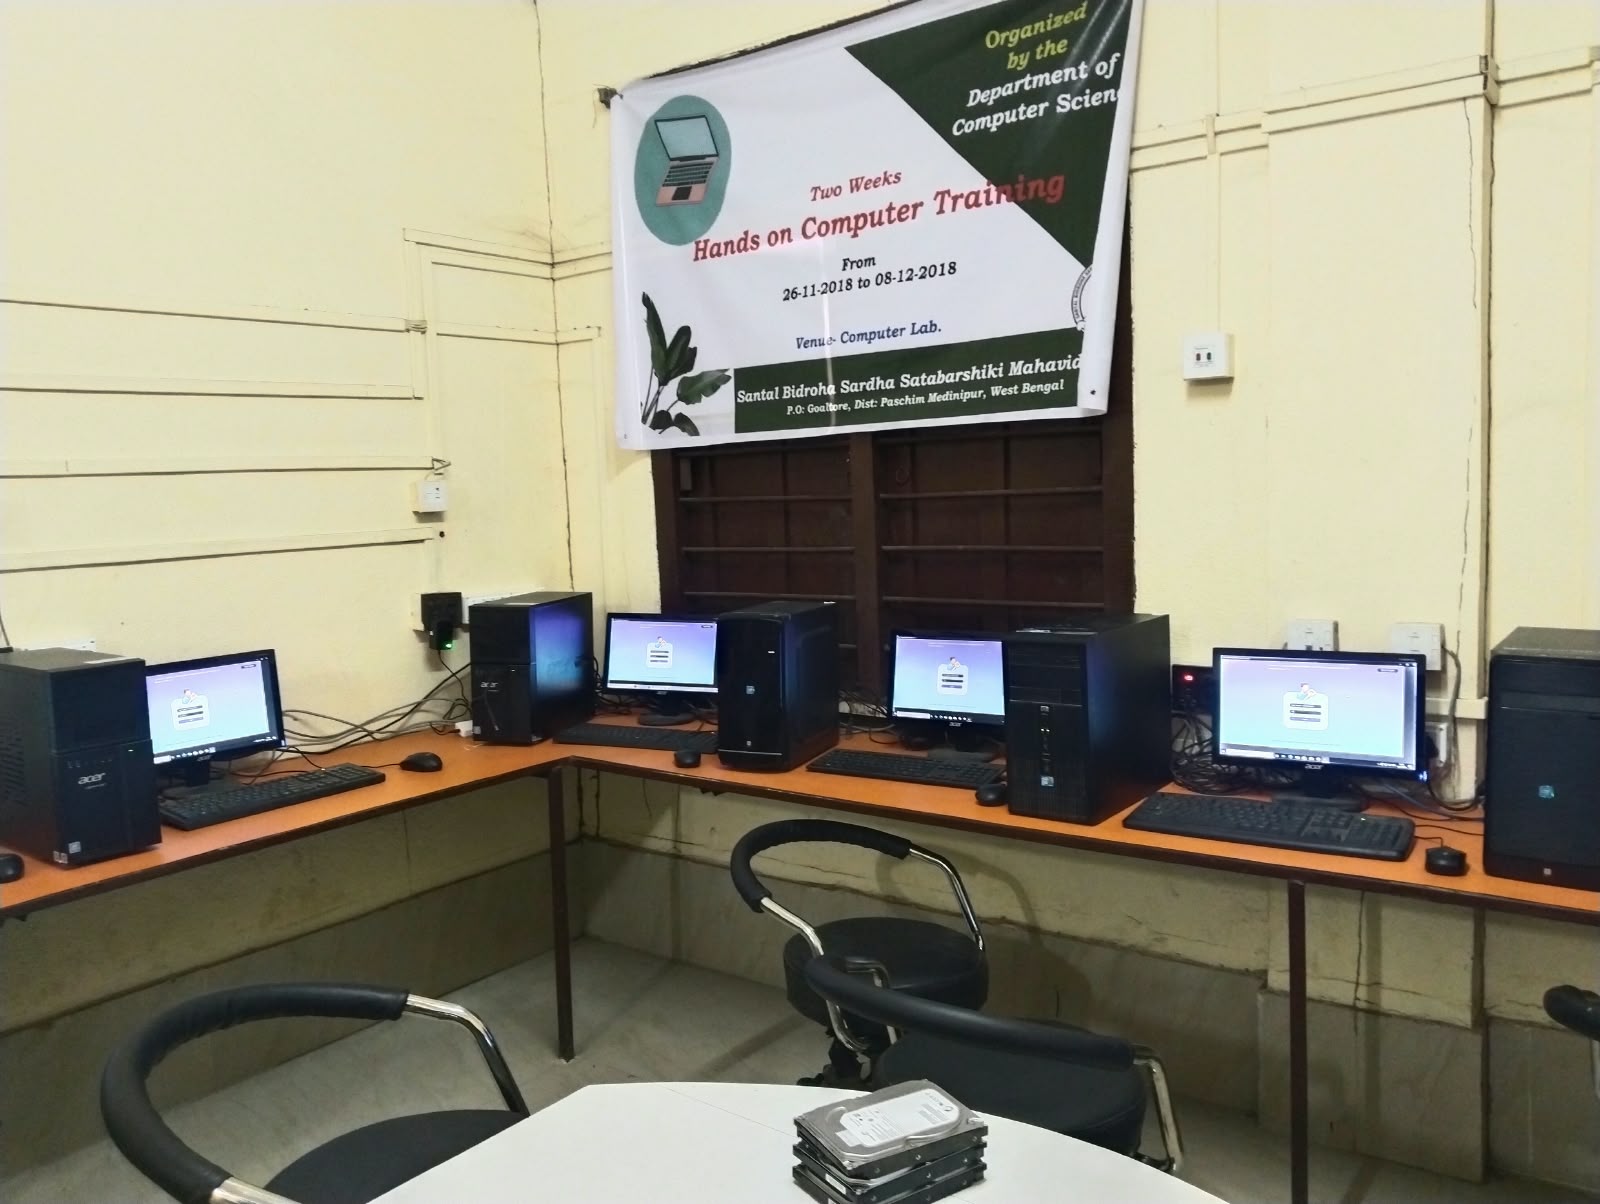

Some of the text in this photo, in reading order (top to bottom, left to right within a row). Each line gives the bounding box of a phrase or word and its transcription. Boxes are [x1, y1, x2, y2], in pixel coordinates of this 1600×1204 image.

[985, 1, 1088, 48] Organized
[1007, 39, 1068, 70] by the
[966, 53, 1121, 107] Department of
[952, 100, 1049, 135] Computer
[810, 170, 902, 202] Two Weeks
[692, 174, 1065, 262] Hands on Computer Training
[782, 261, 957, 301] 26-11-2018 to 08-12-2018
[841, 256, 876, 271] From
[840, 325, 906, 344] Computer
[910, 320, 942, 336] Lab.
[737, 386, 780, 403] Santal
[782, 382, 836, 399] Bidroha
[840, 376, 896, 394] Sardha
[900, 362, 1004, 388] Satabarshiki
[787, 379, 1065, 415] P.O: Goaltore, Dist: Paschim Medinipur, West Bengal
